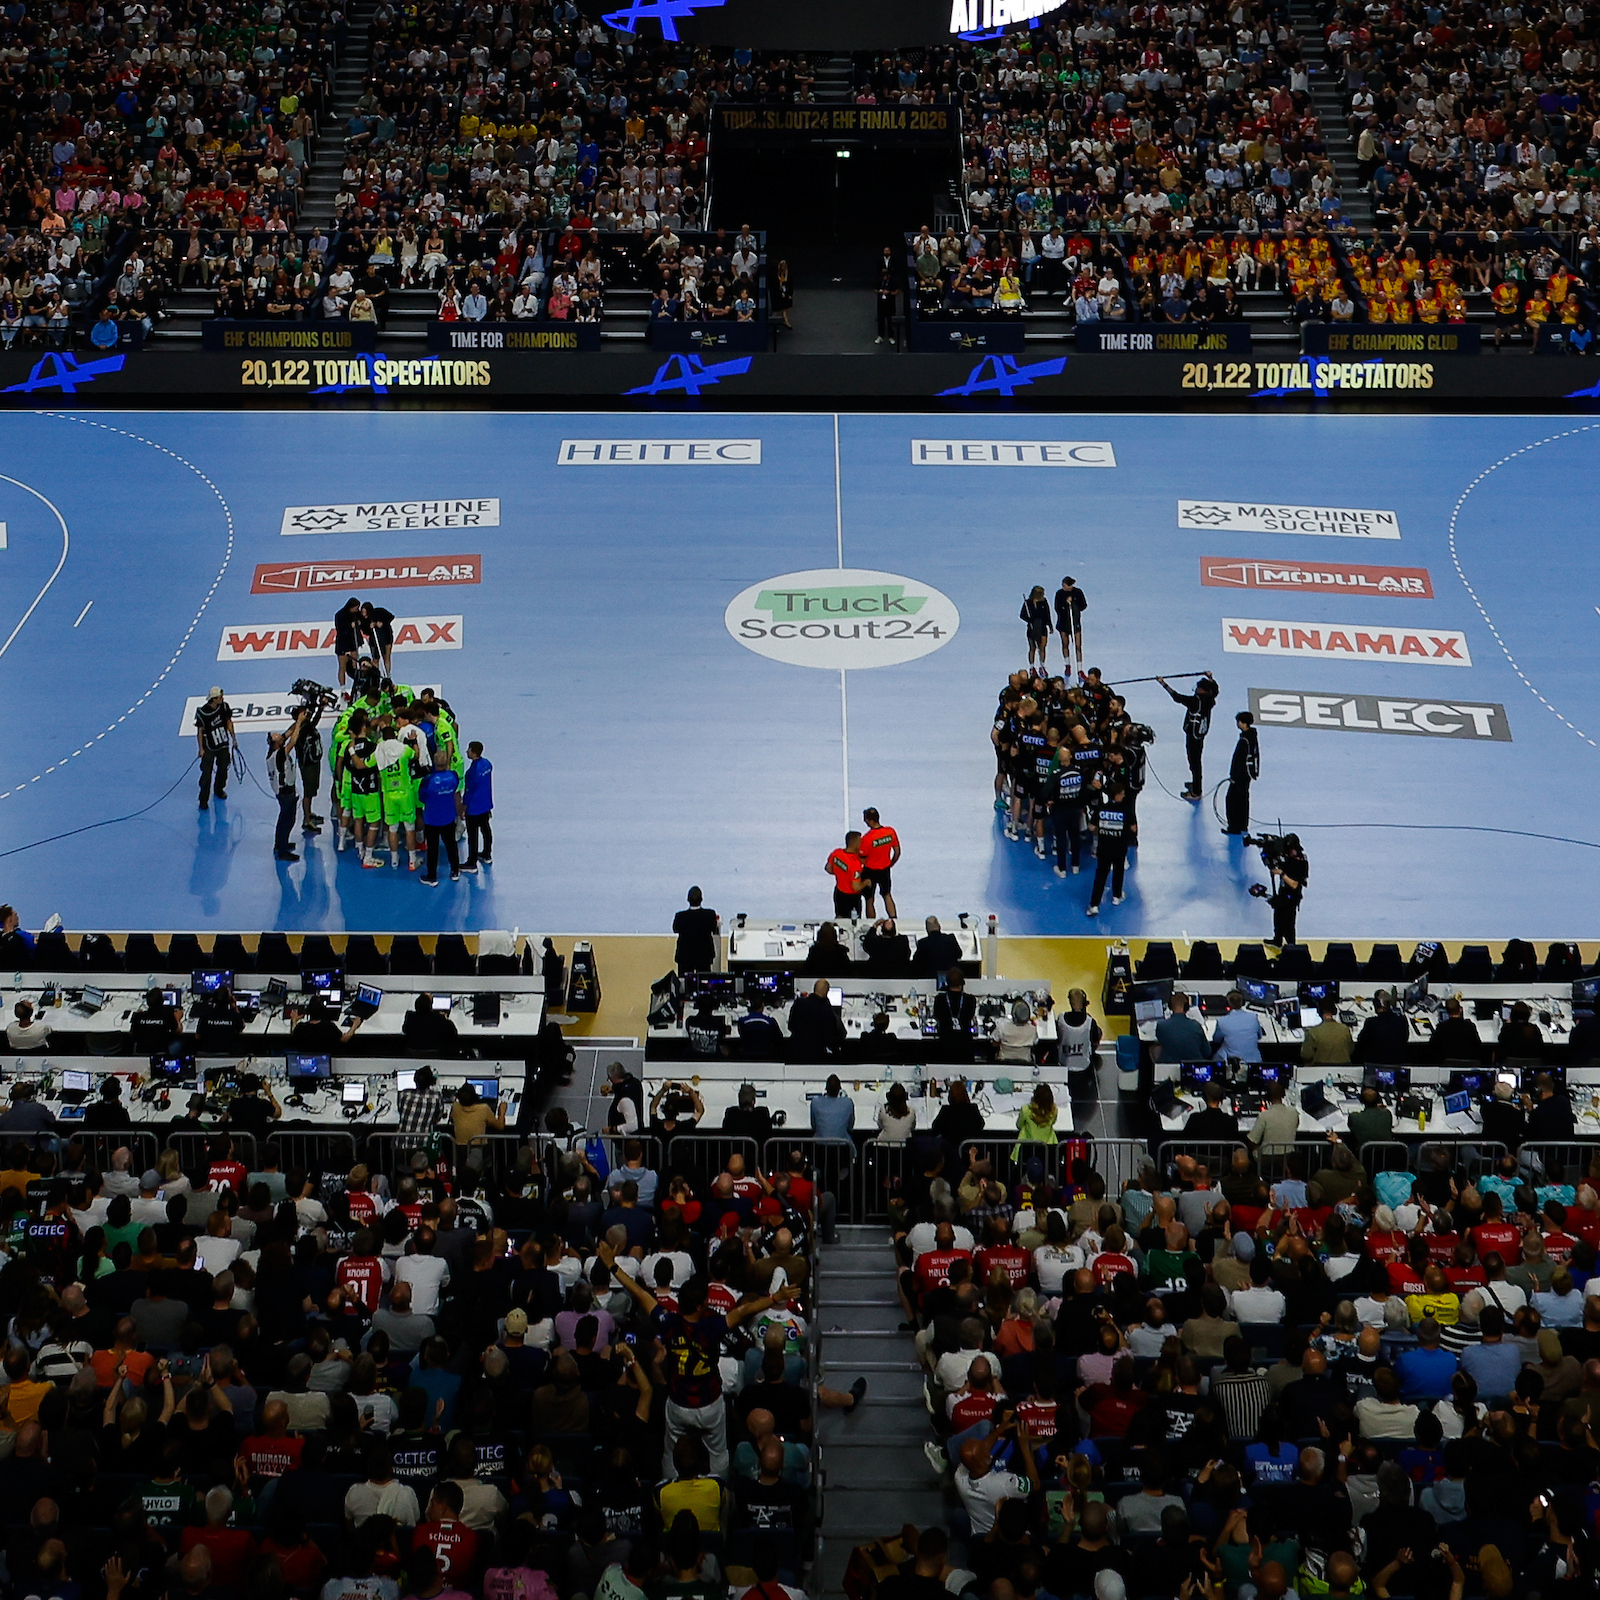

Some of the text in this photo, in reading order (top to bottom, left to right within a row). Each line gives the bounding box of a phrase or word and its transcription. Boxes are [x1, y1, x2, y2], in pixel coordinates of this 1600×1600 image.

[832, 110, 857, 130] EHF
[860, 110, 907, 131] FINAL4
[910, 110, 947, 131] 2026
[224, 330, 353, 348] EHF CHAMPIONS CLUB
[450, 331, 578, 349] TIME FOR CHAMPIONS
[1099, 333, 1127, 350] TIME
[1129, 333, 1153, 350] FOR
[1328, 333, 1458, 351] EHF CHAMPIONS CLUB
[241, 359, 491, 388] 20,122 TOTAL SPECTATORS
[1182, 362, 1434, 391] 20,122 TOTAL SPECTATORS
[566, 443, 753, 461] HEITEC
[919, 443, 1106, 464] HEITEC
[356, 501, 491, 516] MACHINE
[1238, 506, 1393, 524] MASCHINEN
[366, 514, 481, 529] SEEKER
[1265, 519, 1371, 535] SUCHER
[315, 564, 475, 583] MODULAR
[428, 573, 474, 582] SYSTEM
[1263, 568, 1424, 589] MODULAR
[1378, 585, 1425, 594] SYSTEM
[774, 592, 909, 614] Truck
[226, 621, 456, 653] WINAAX
[738, 619, 947, 641] Scout24
[1228, 625, 1464, 660] WINAMAX
[1259, 693, 1495, 737] SELECT
[1022, 735, 1045, 746] GETEC
[1074, 750, 1099, 760] GETEC
[1060, 775, 1082, 787] GETEC
[1099, 810, 1124, 821] GETEC
[29, 1224, 65, 1236] GETEC
[1403, 1282, 1426, 1292] GIDSEL
[394, 1451, 436, 1464] GETEC
[144, 1499, 172, 1510] HYLO
[435, 1543, 452, 1573] 5
